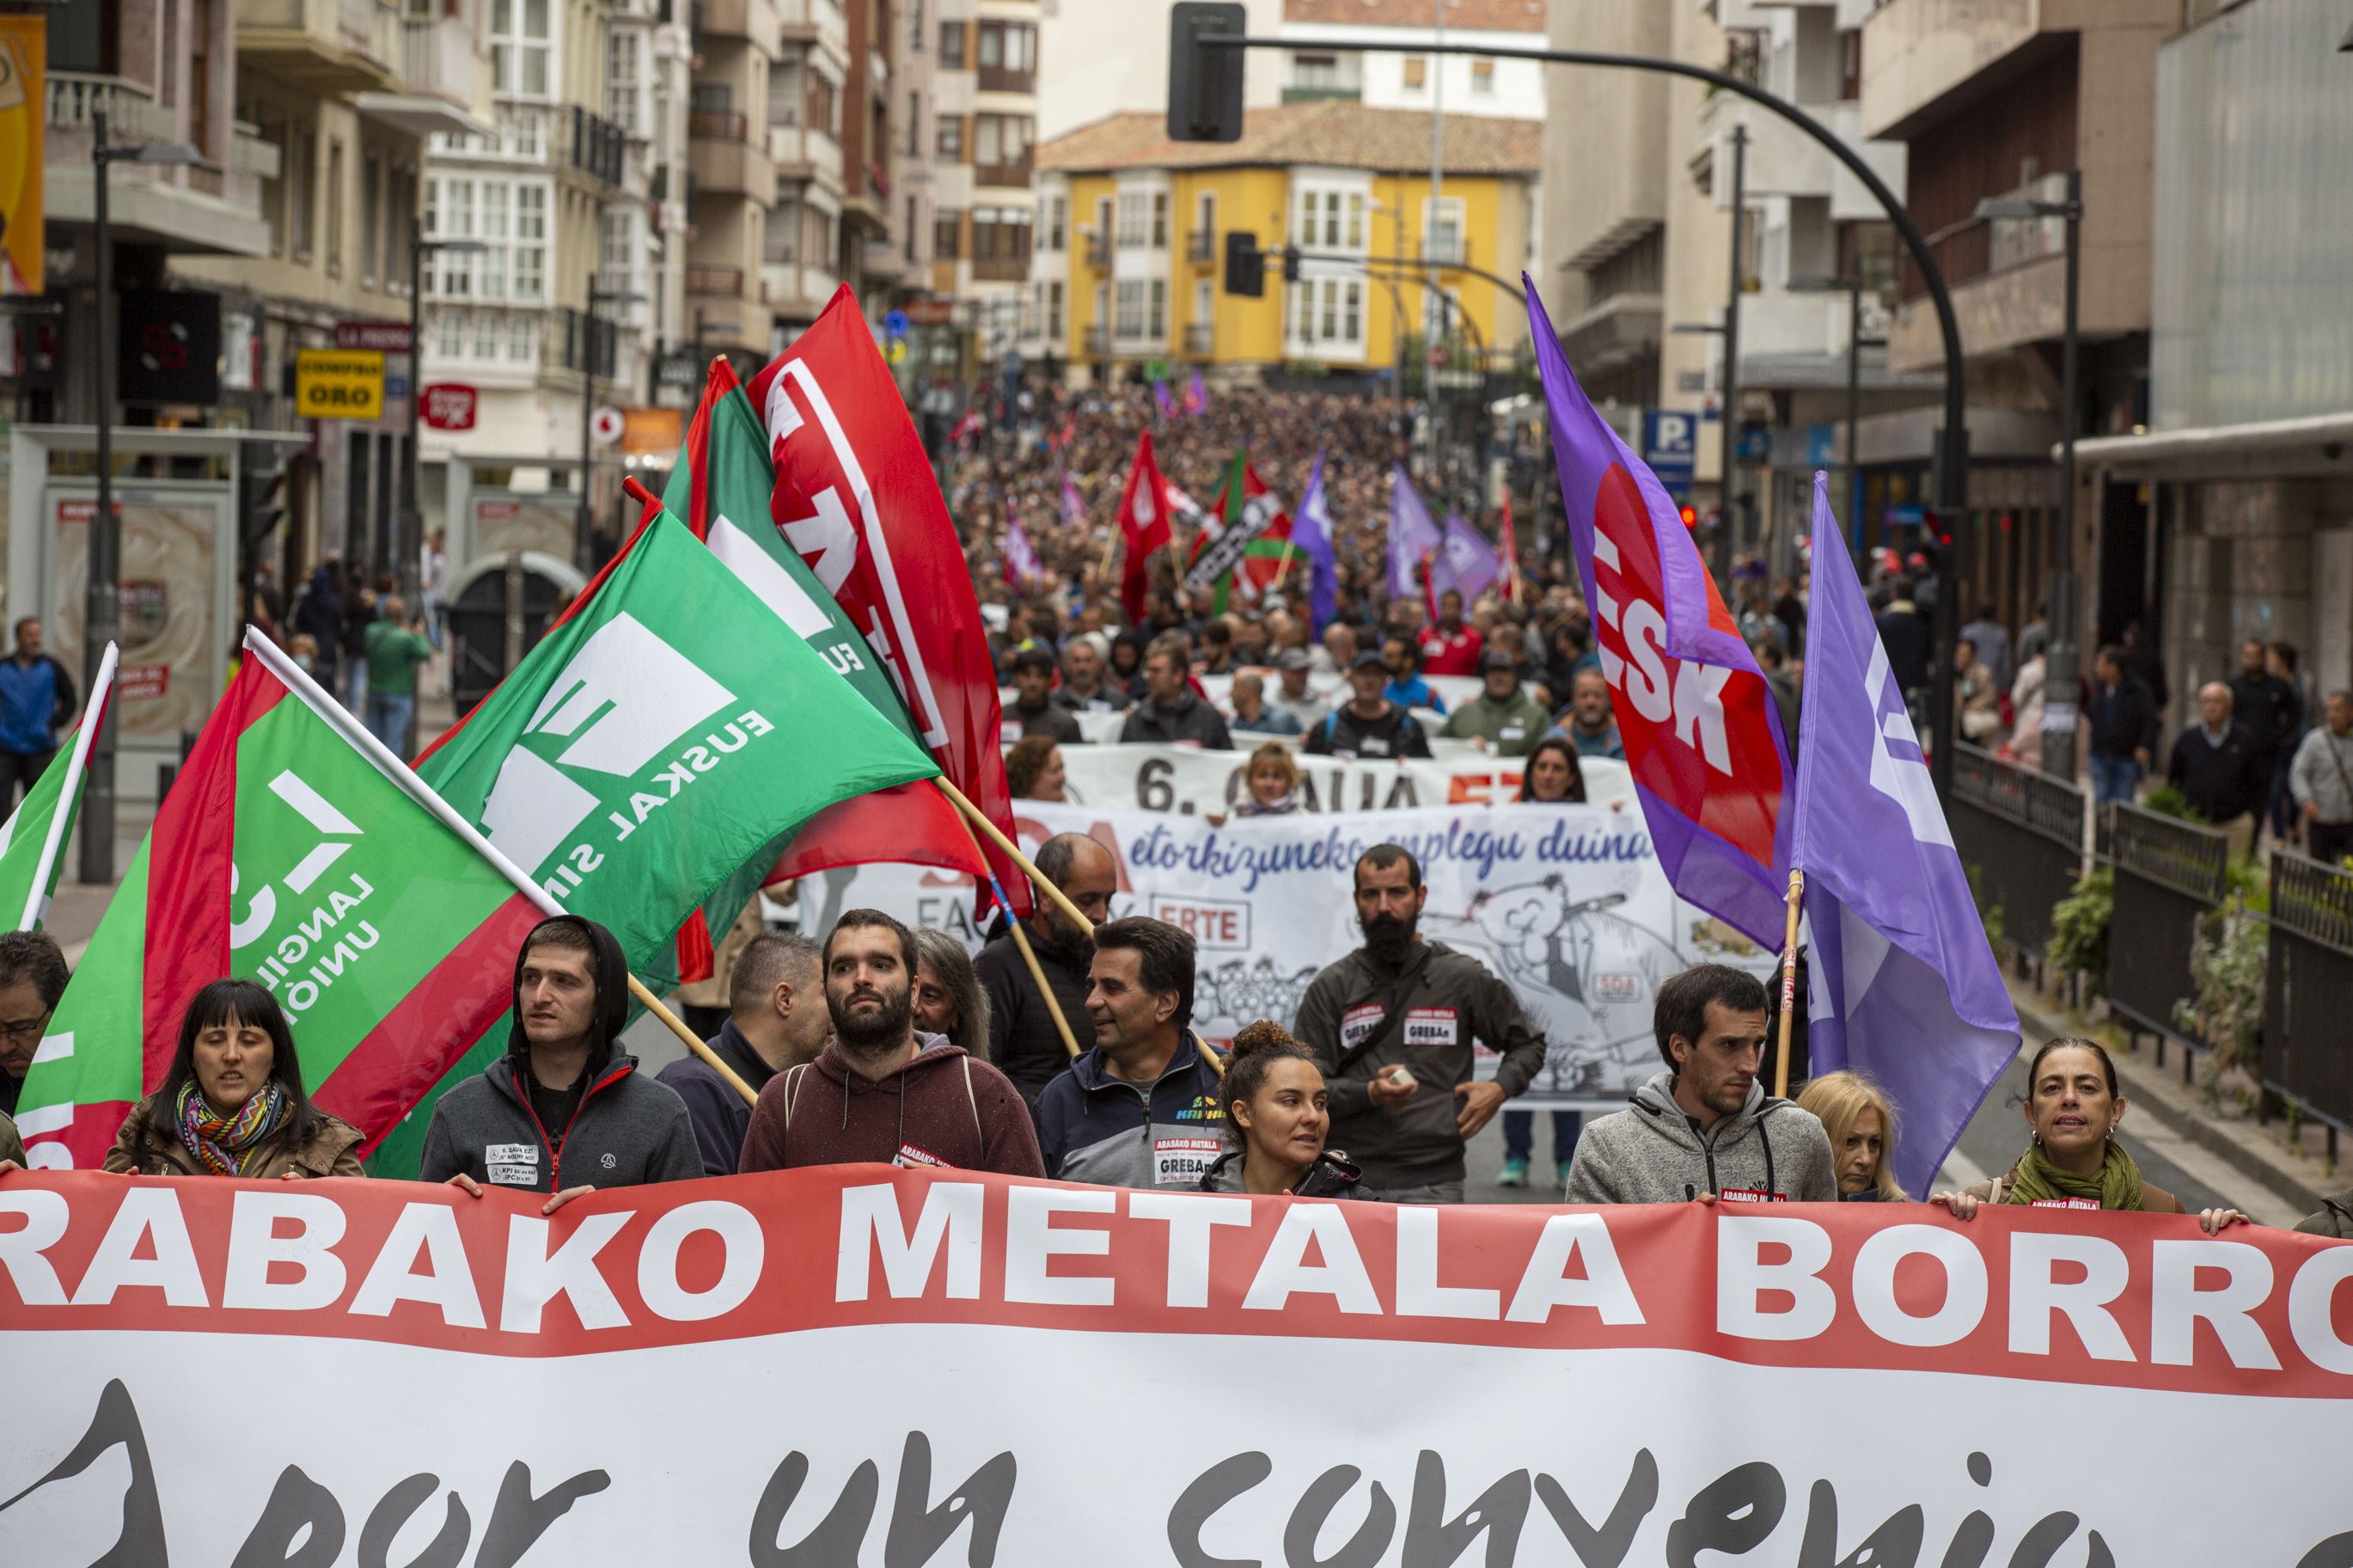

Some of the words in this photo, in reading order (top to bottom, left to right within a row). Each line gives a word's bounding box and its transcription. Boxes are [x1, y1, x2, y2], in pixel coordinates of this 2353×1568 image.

[309, 387, 371, 406] ORO
[1659, 417, 1688, 449] P
[1136, 758, 1195, 815] 6.
[901, 1144, 936, 1164] ARABAKO
[1157, 1139, 1189, 1150] ARABAKO
[1190, 1140, 1218, 1150] METALA
[1723, 1191, 1758, 1203] ARABAKO
[2068, 1199, 2097, 1211] METALA
[835, 1182, 1647, 1326] METALA
